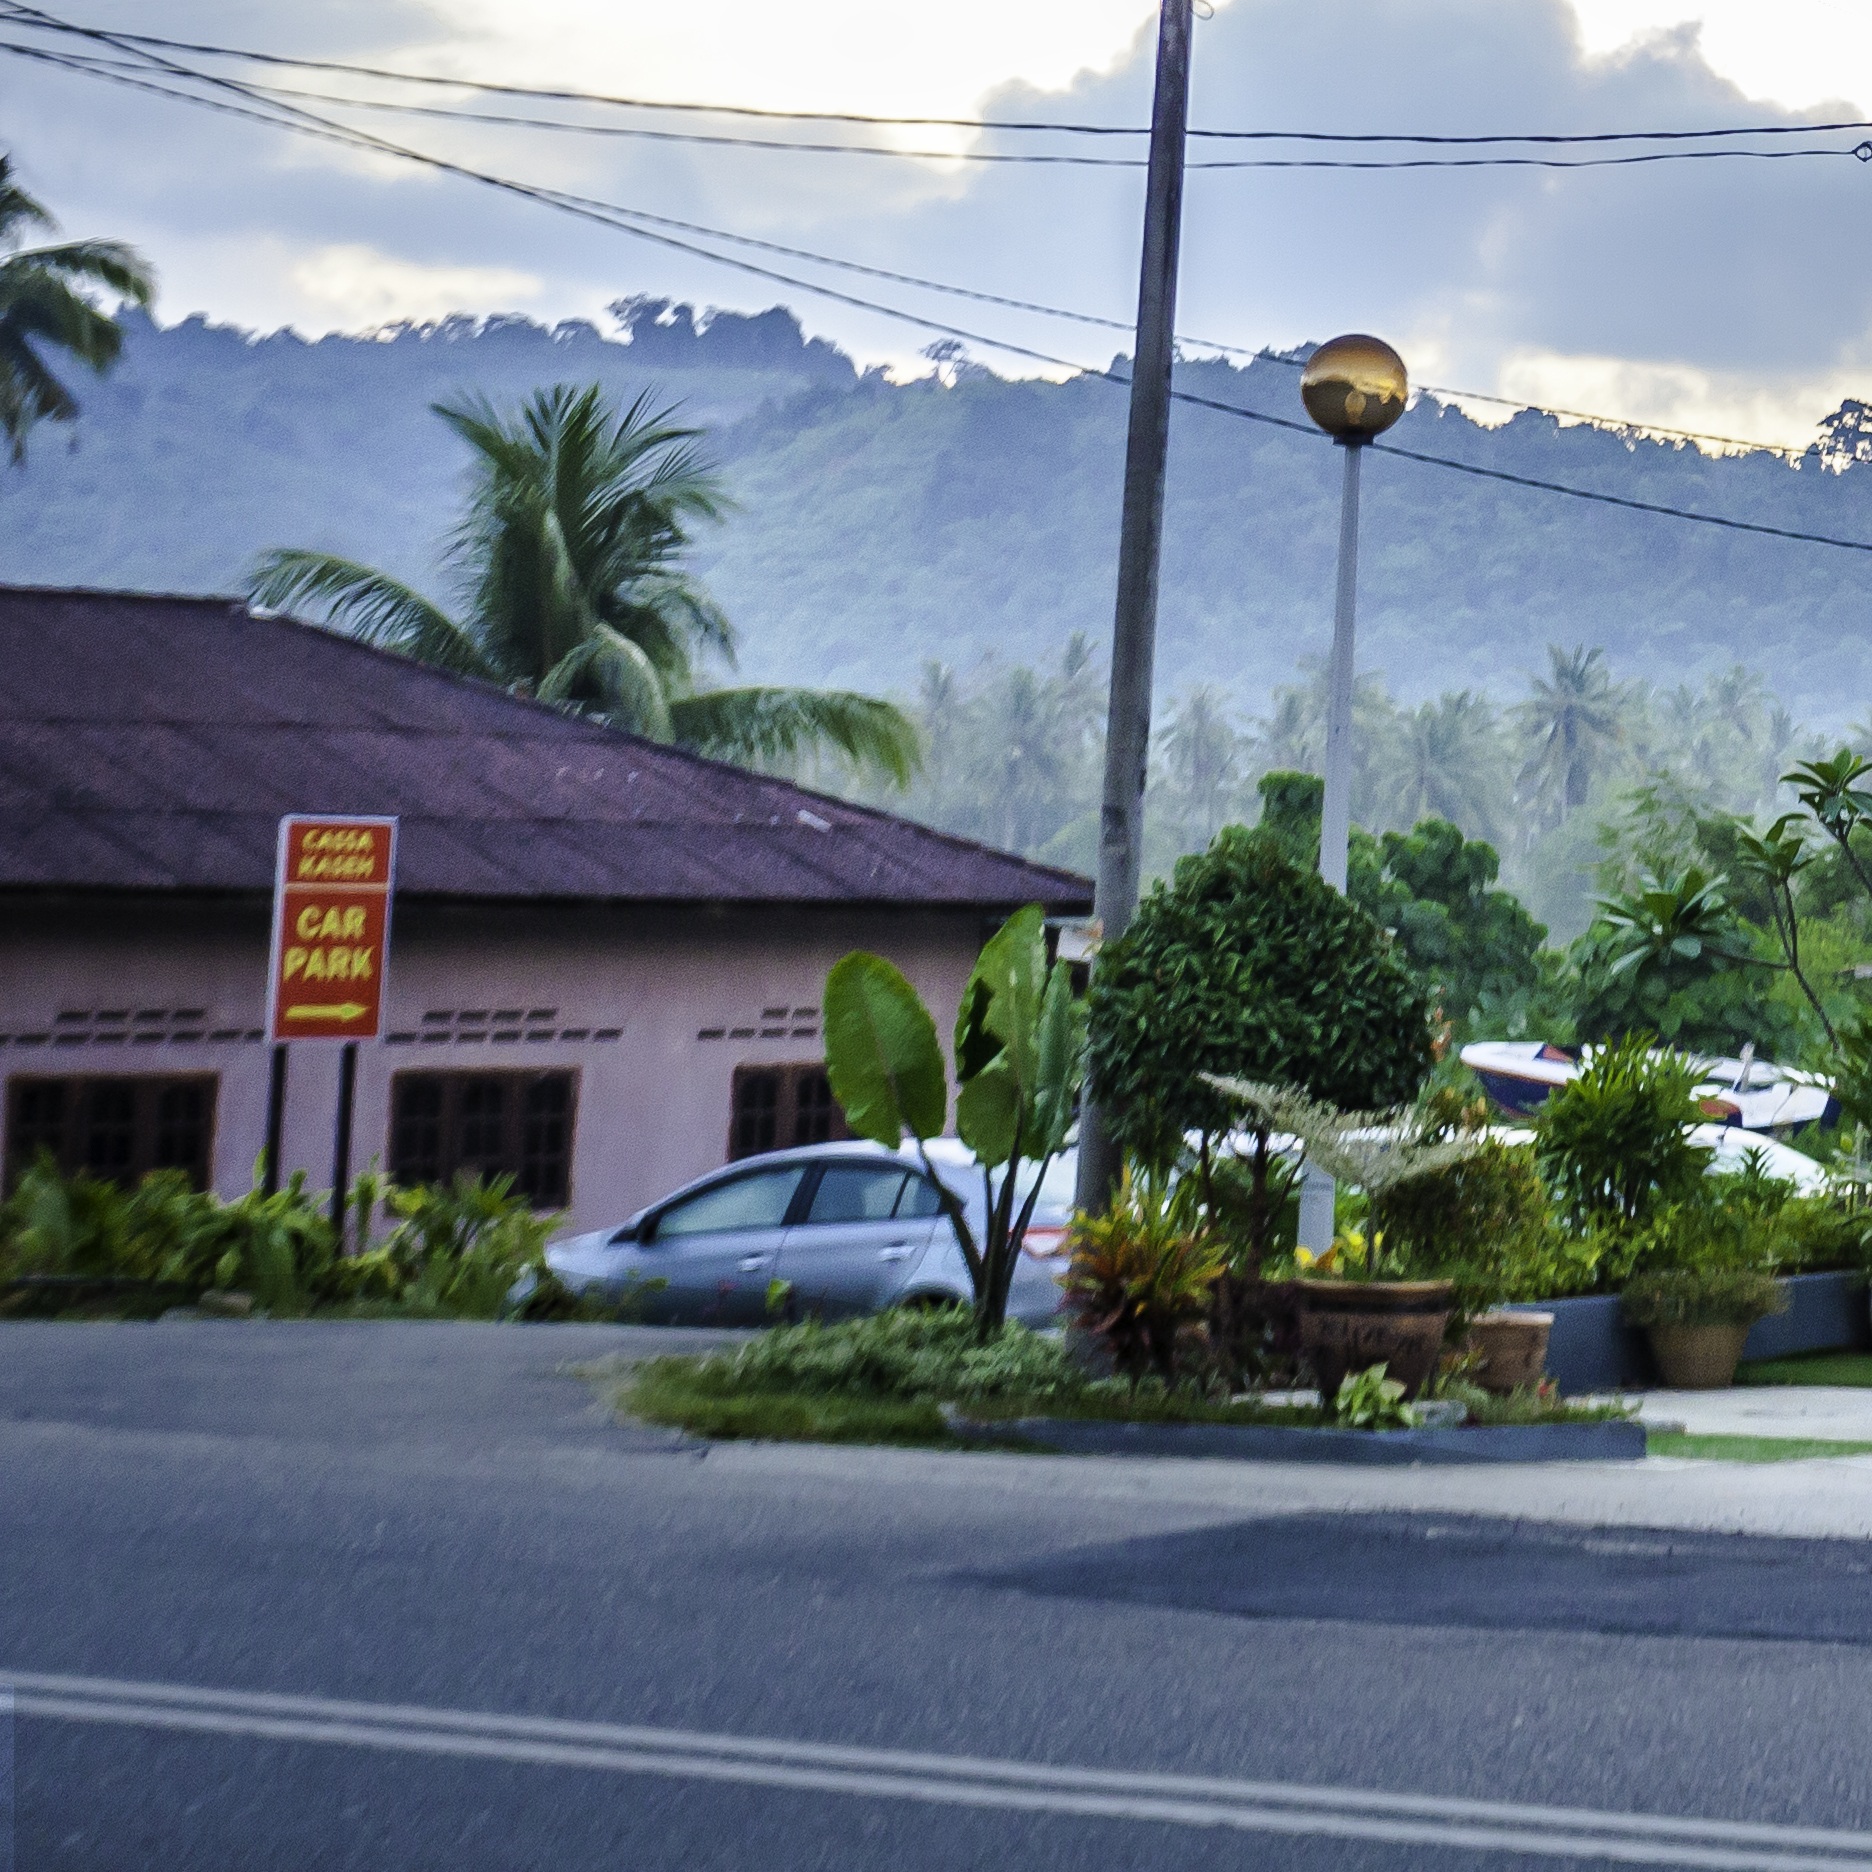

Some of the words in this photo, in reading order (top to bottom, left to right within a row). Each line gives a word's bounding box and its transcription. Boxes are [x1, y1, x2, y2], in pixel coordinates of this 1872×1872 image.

[301, 828, 375, 852] CASSA
[297, 854, 376, 880] KASEH
[296, 905, 368, 941] CAR
[283, 945, 376, 983] PARK
